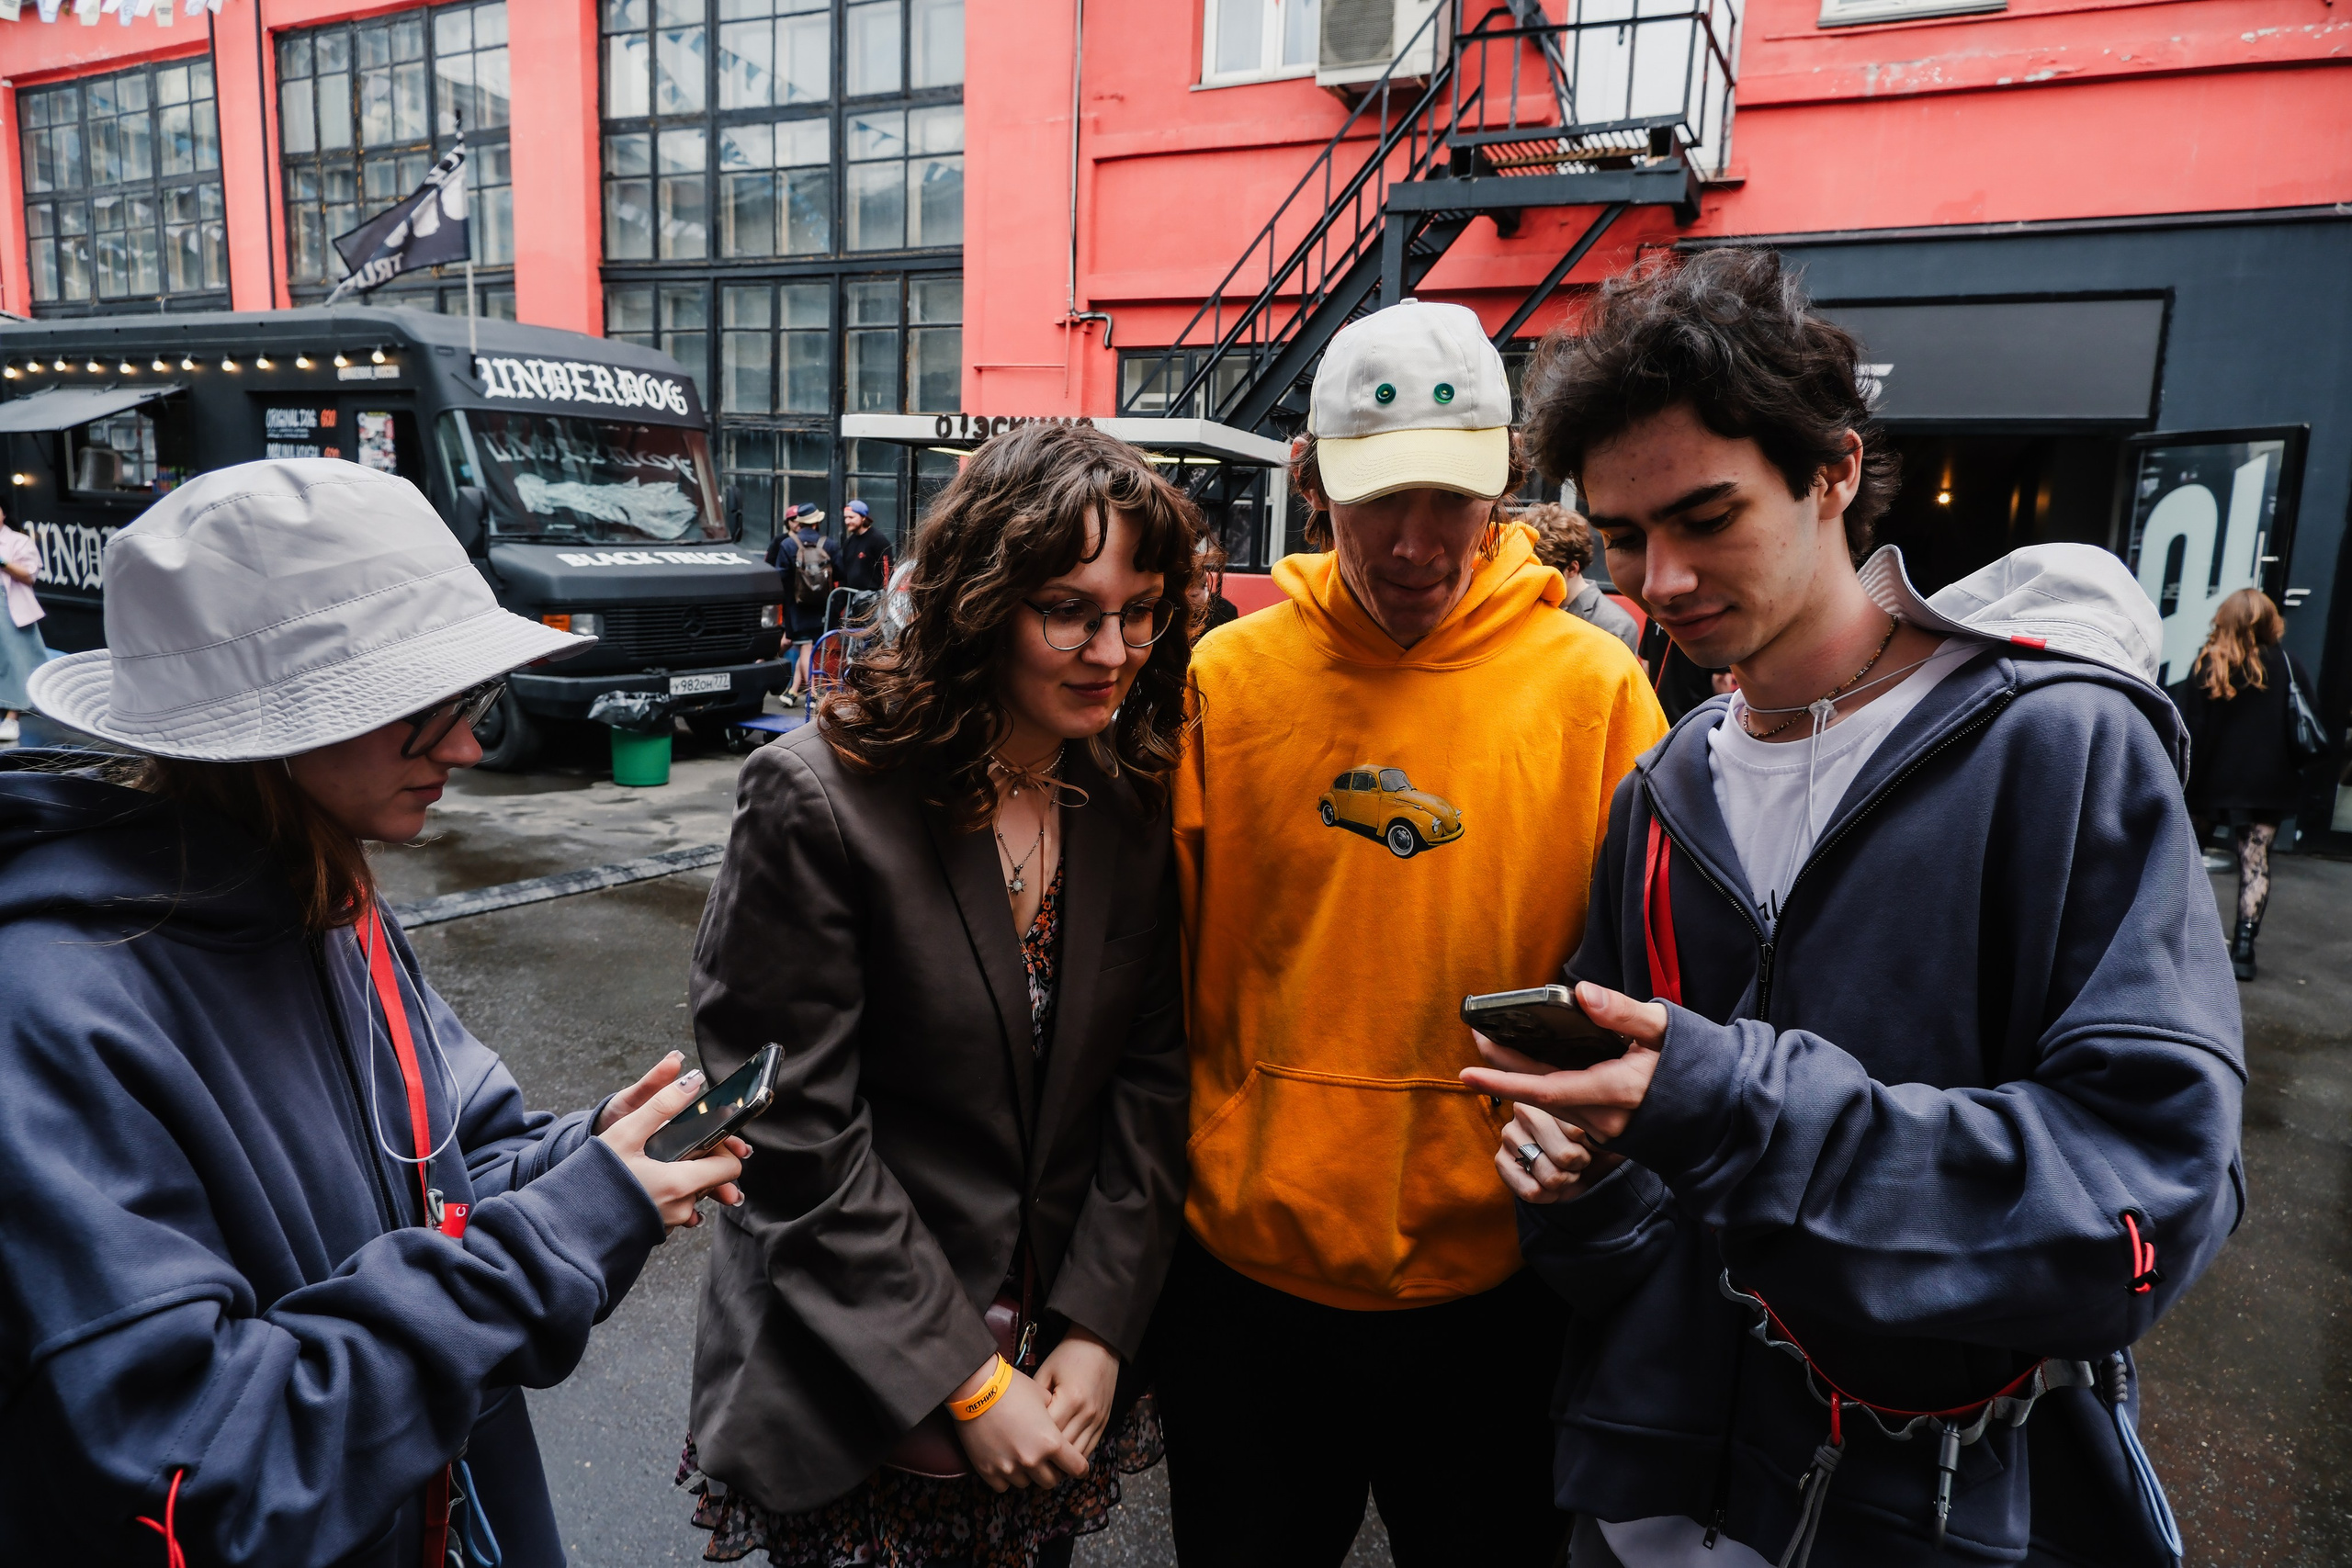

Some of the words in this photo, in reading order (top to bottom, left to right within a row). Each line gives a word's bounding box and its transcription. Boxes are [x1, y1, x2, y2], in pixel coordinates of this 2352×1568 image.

[476, 357, 689, 415] UNDERDOG
[24, 520, 120, 591] UND
[556, 552, 664, 567] BLACK
[653, 551, 752, 565] TRUCK
[967, 1386, 998, 1413] ЛЕТНИК
